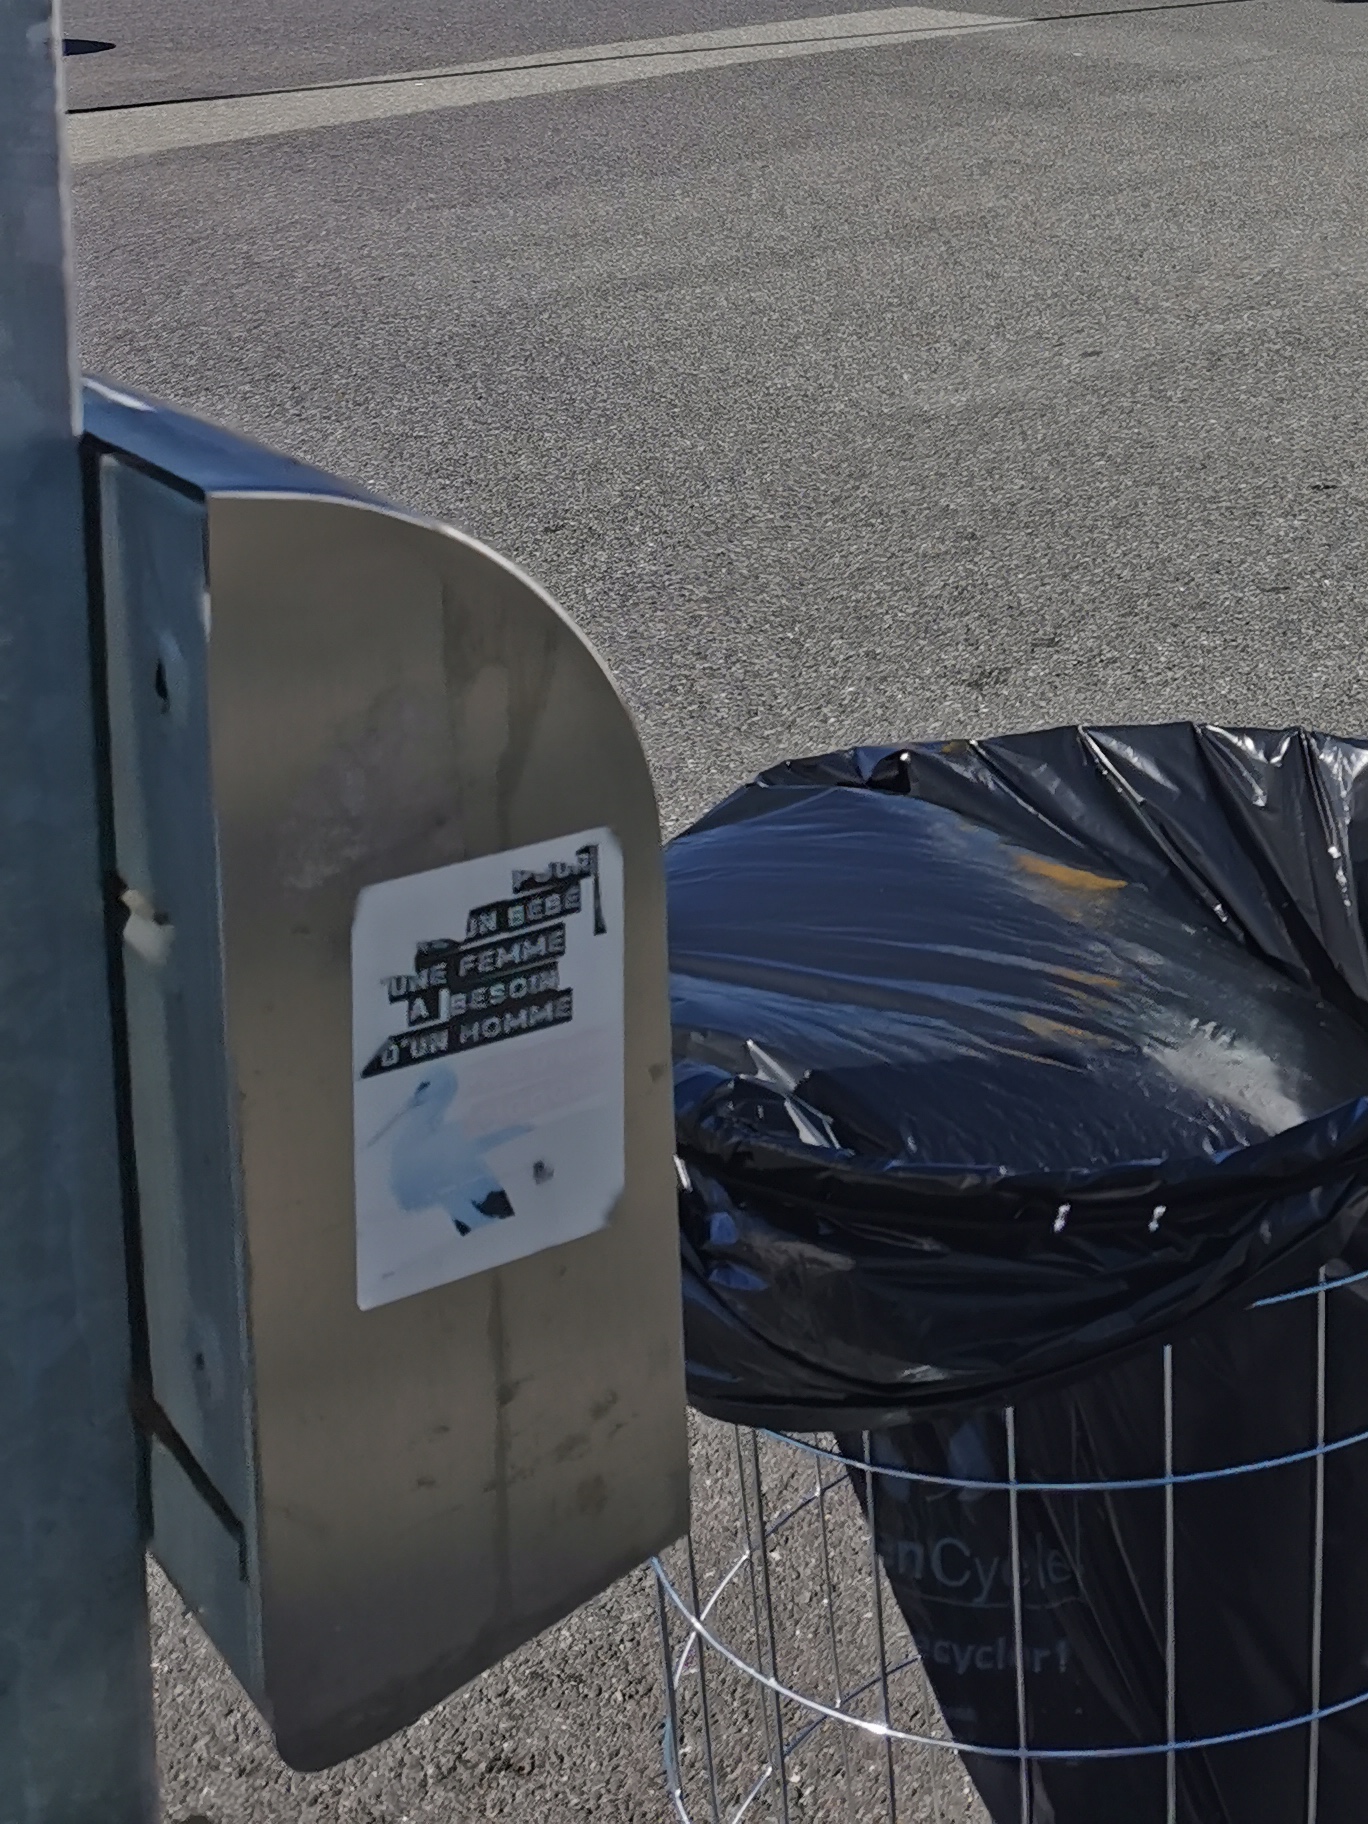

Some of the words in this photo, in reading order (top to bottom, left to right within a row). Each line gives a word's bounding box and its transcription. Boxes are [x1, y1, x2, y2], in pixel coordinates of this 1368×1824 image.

[458, 928, 565, 978] FEMME
[410, 997, 430, 1022] A
[451, 968, 560, 1018] BESOIN
[459, 994, 573, 1045] HOMME
[879, 1532, 1073, 1605] nCycle
